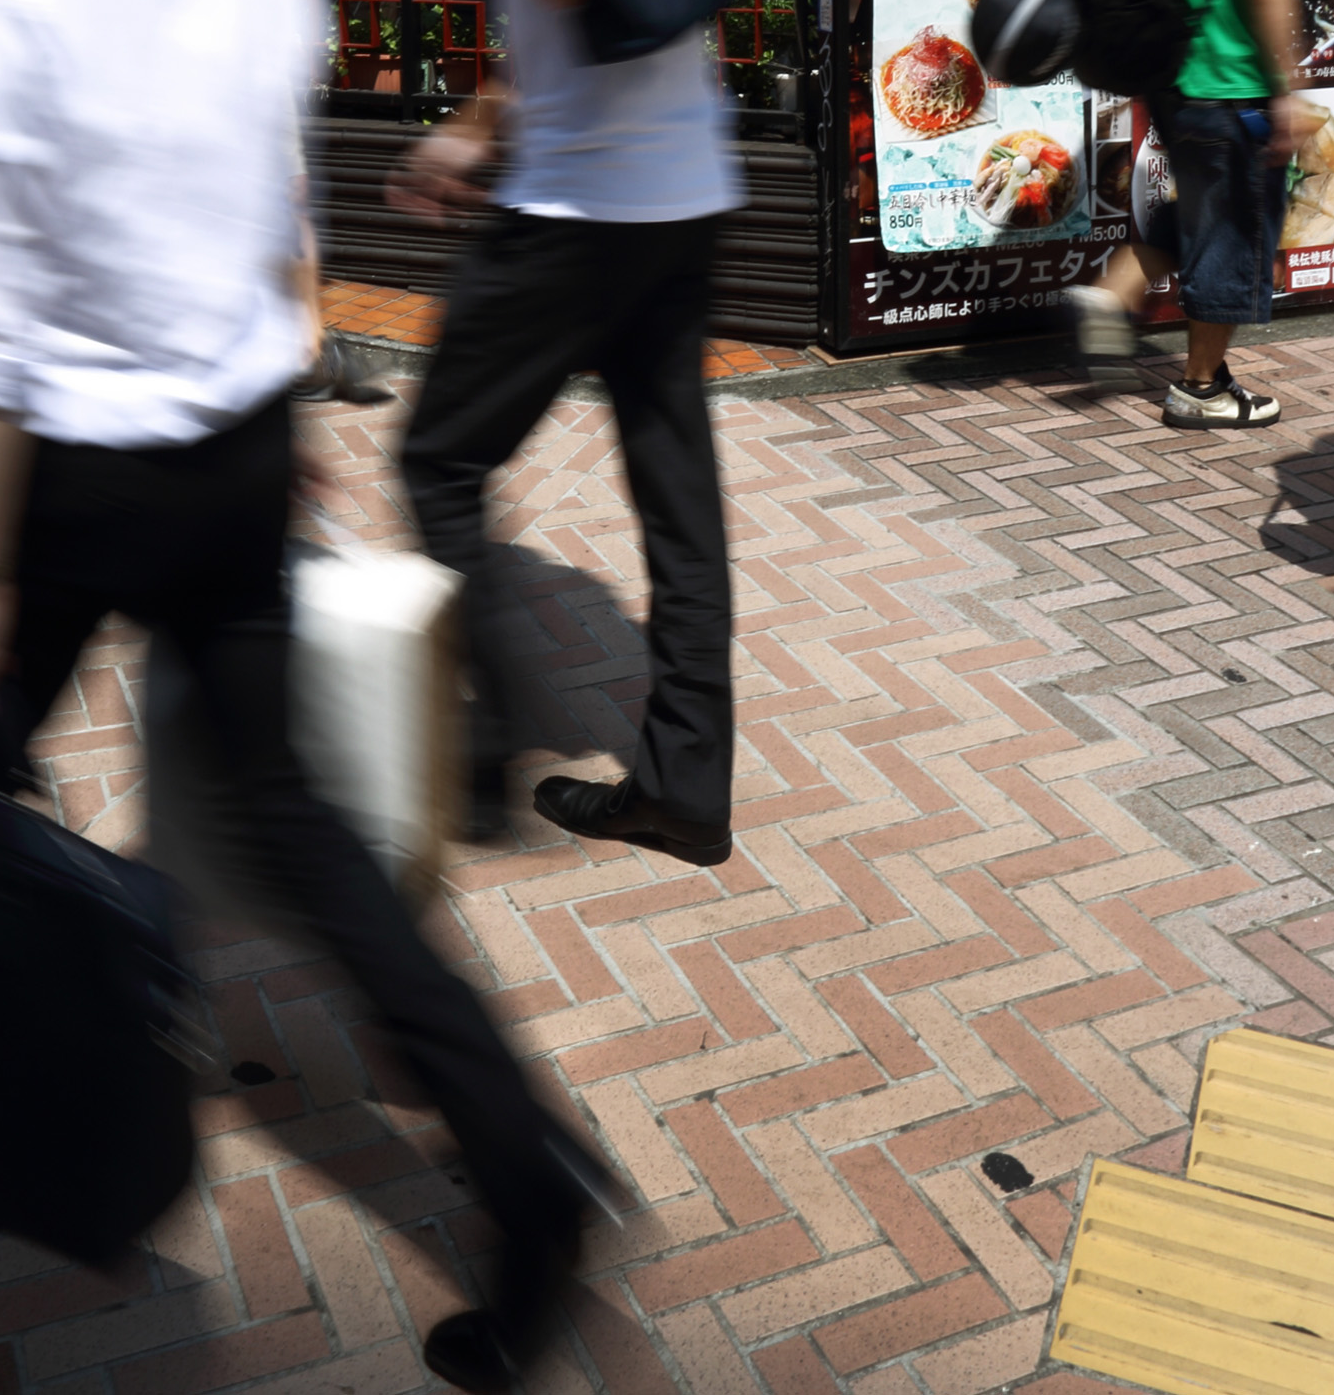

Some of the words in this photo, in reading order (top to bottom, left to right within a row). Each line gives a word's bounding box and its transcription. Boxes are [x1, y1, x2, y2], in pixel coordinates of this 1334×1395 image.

[889, 214, 924, 229] 850円
[863, 245, 1117, 305] チンズカフェタイ
